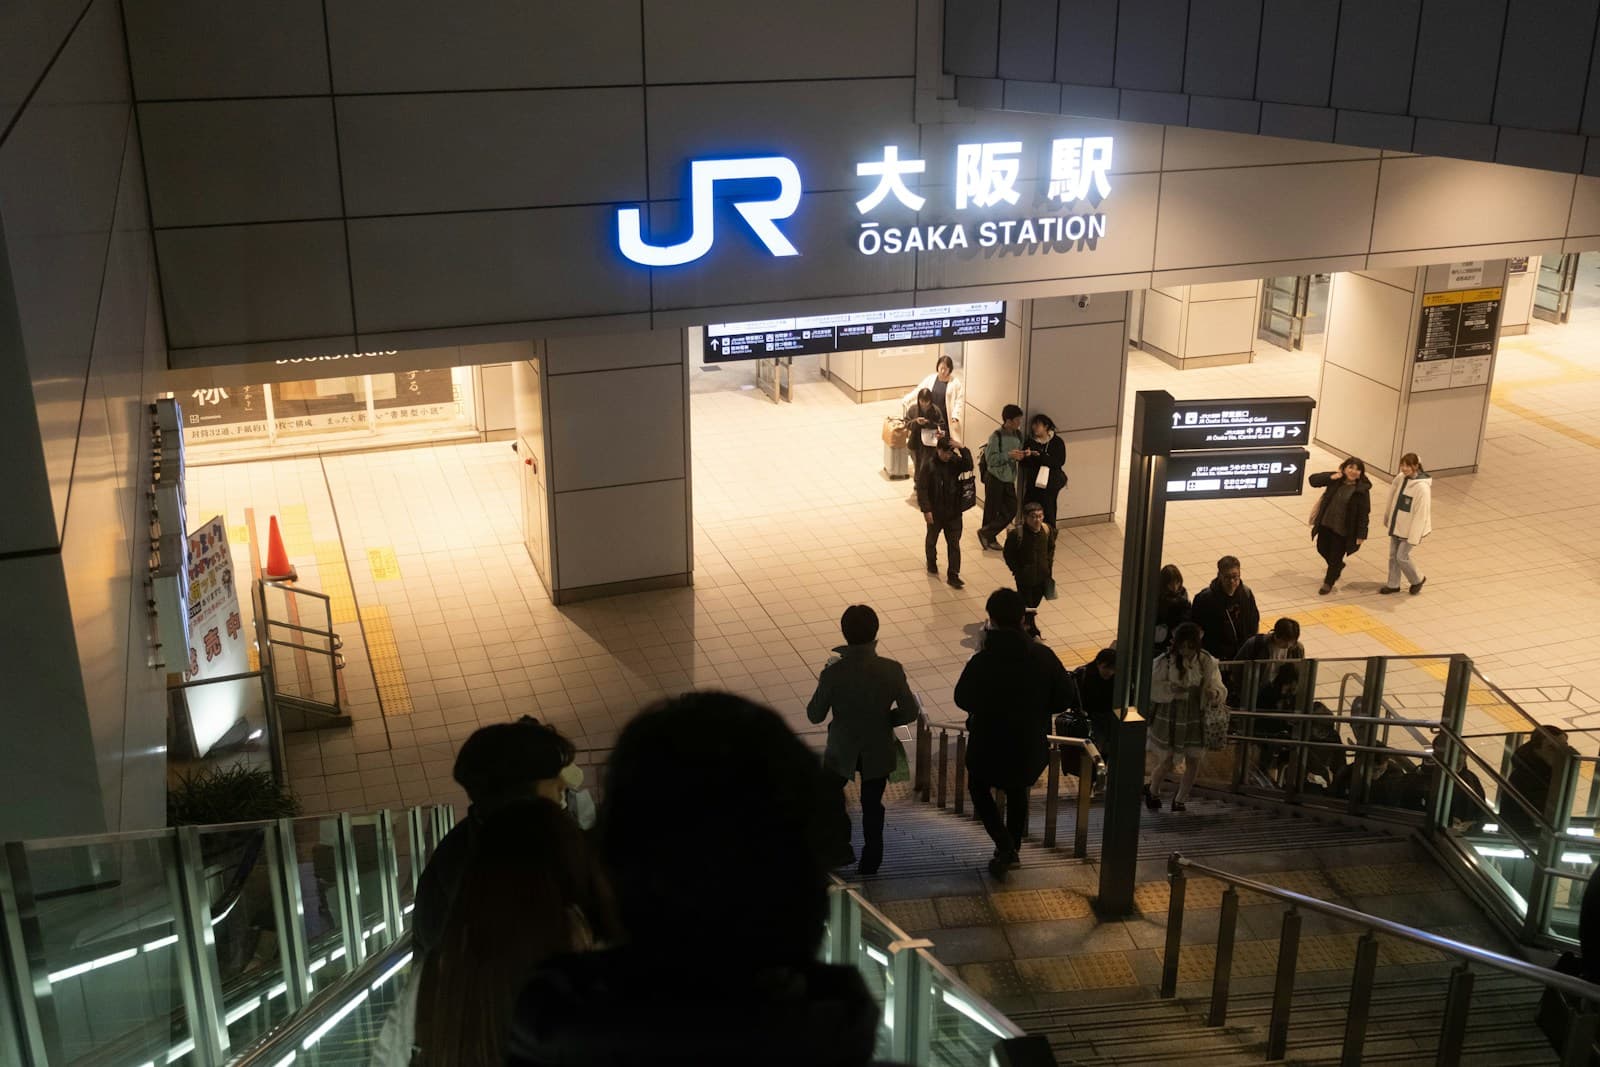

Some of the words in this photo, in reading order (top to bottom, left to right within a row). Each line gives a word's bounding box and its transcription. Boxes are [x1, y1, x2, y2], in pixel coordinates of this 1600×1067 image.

[617, 156, 803, 266] JR
[855, 137, 1114, 214] 大阪駅
[979, 214, 1107, 248] STATION
